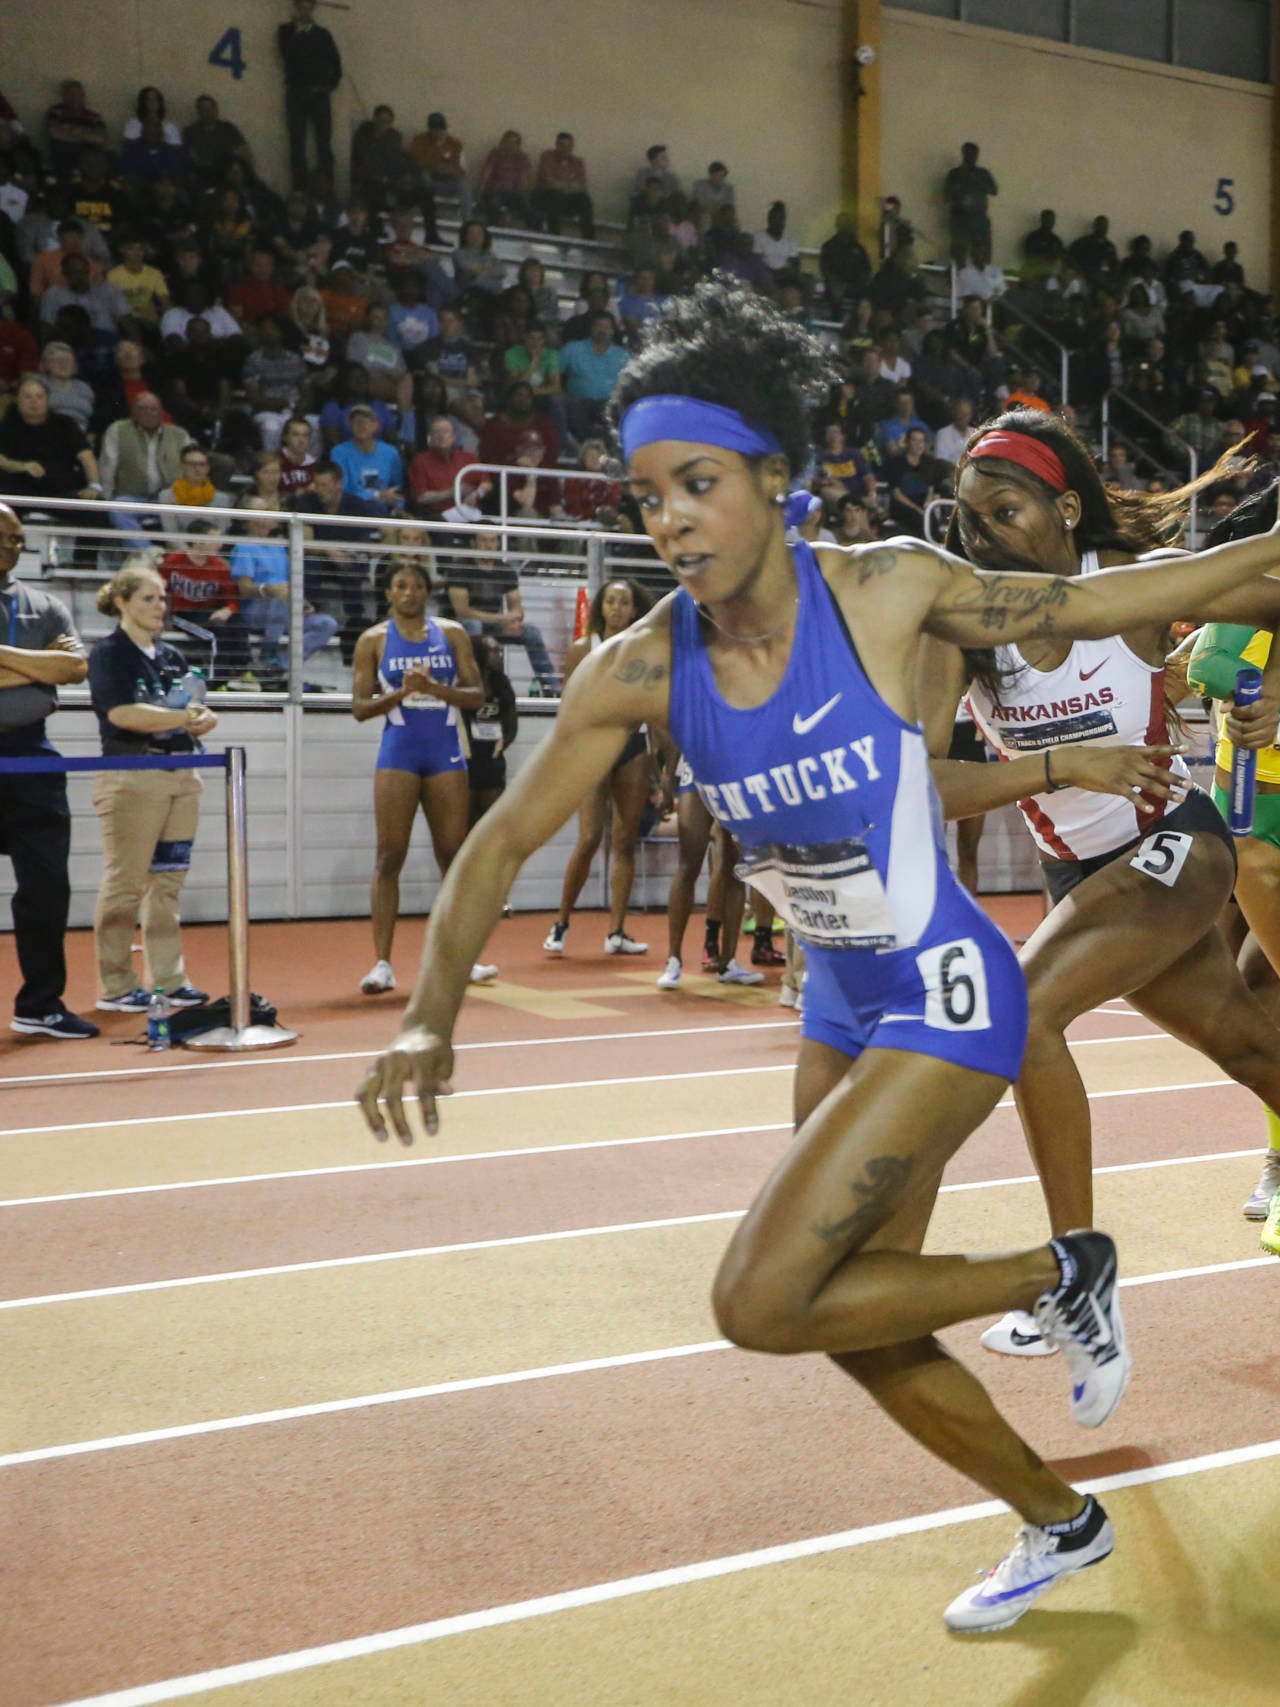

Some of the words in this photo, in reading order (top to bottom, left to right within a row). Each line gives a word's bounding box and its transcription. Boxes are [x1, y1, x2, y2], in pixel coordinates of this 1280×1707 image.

[208, 27, 247, 80] 4
[1213, 177, 1235, 216] 5
[991, 686, 1115, 722] ARKANSAS
[1042, 735, 1060, 747] FIELD
[1060, 722, 1114, 743] CHAMPIONSHIPS
[1142, 833, 1182, 875] 5
[790, 903, 850, 930] Carter
[940, 946, 976, 1026] 6
